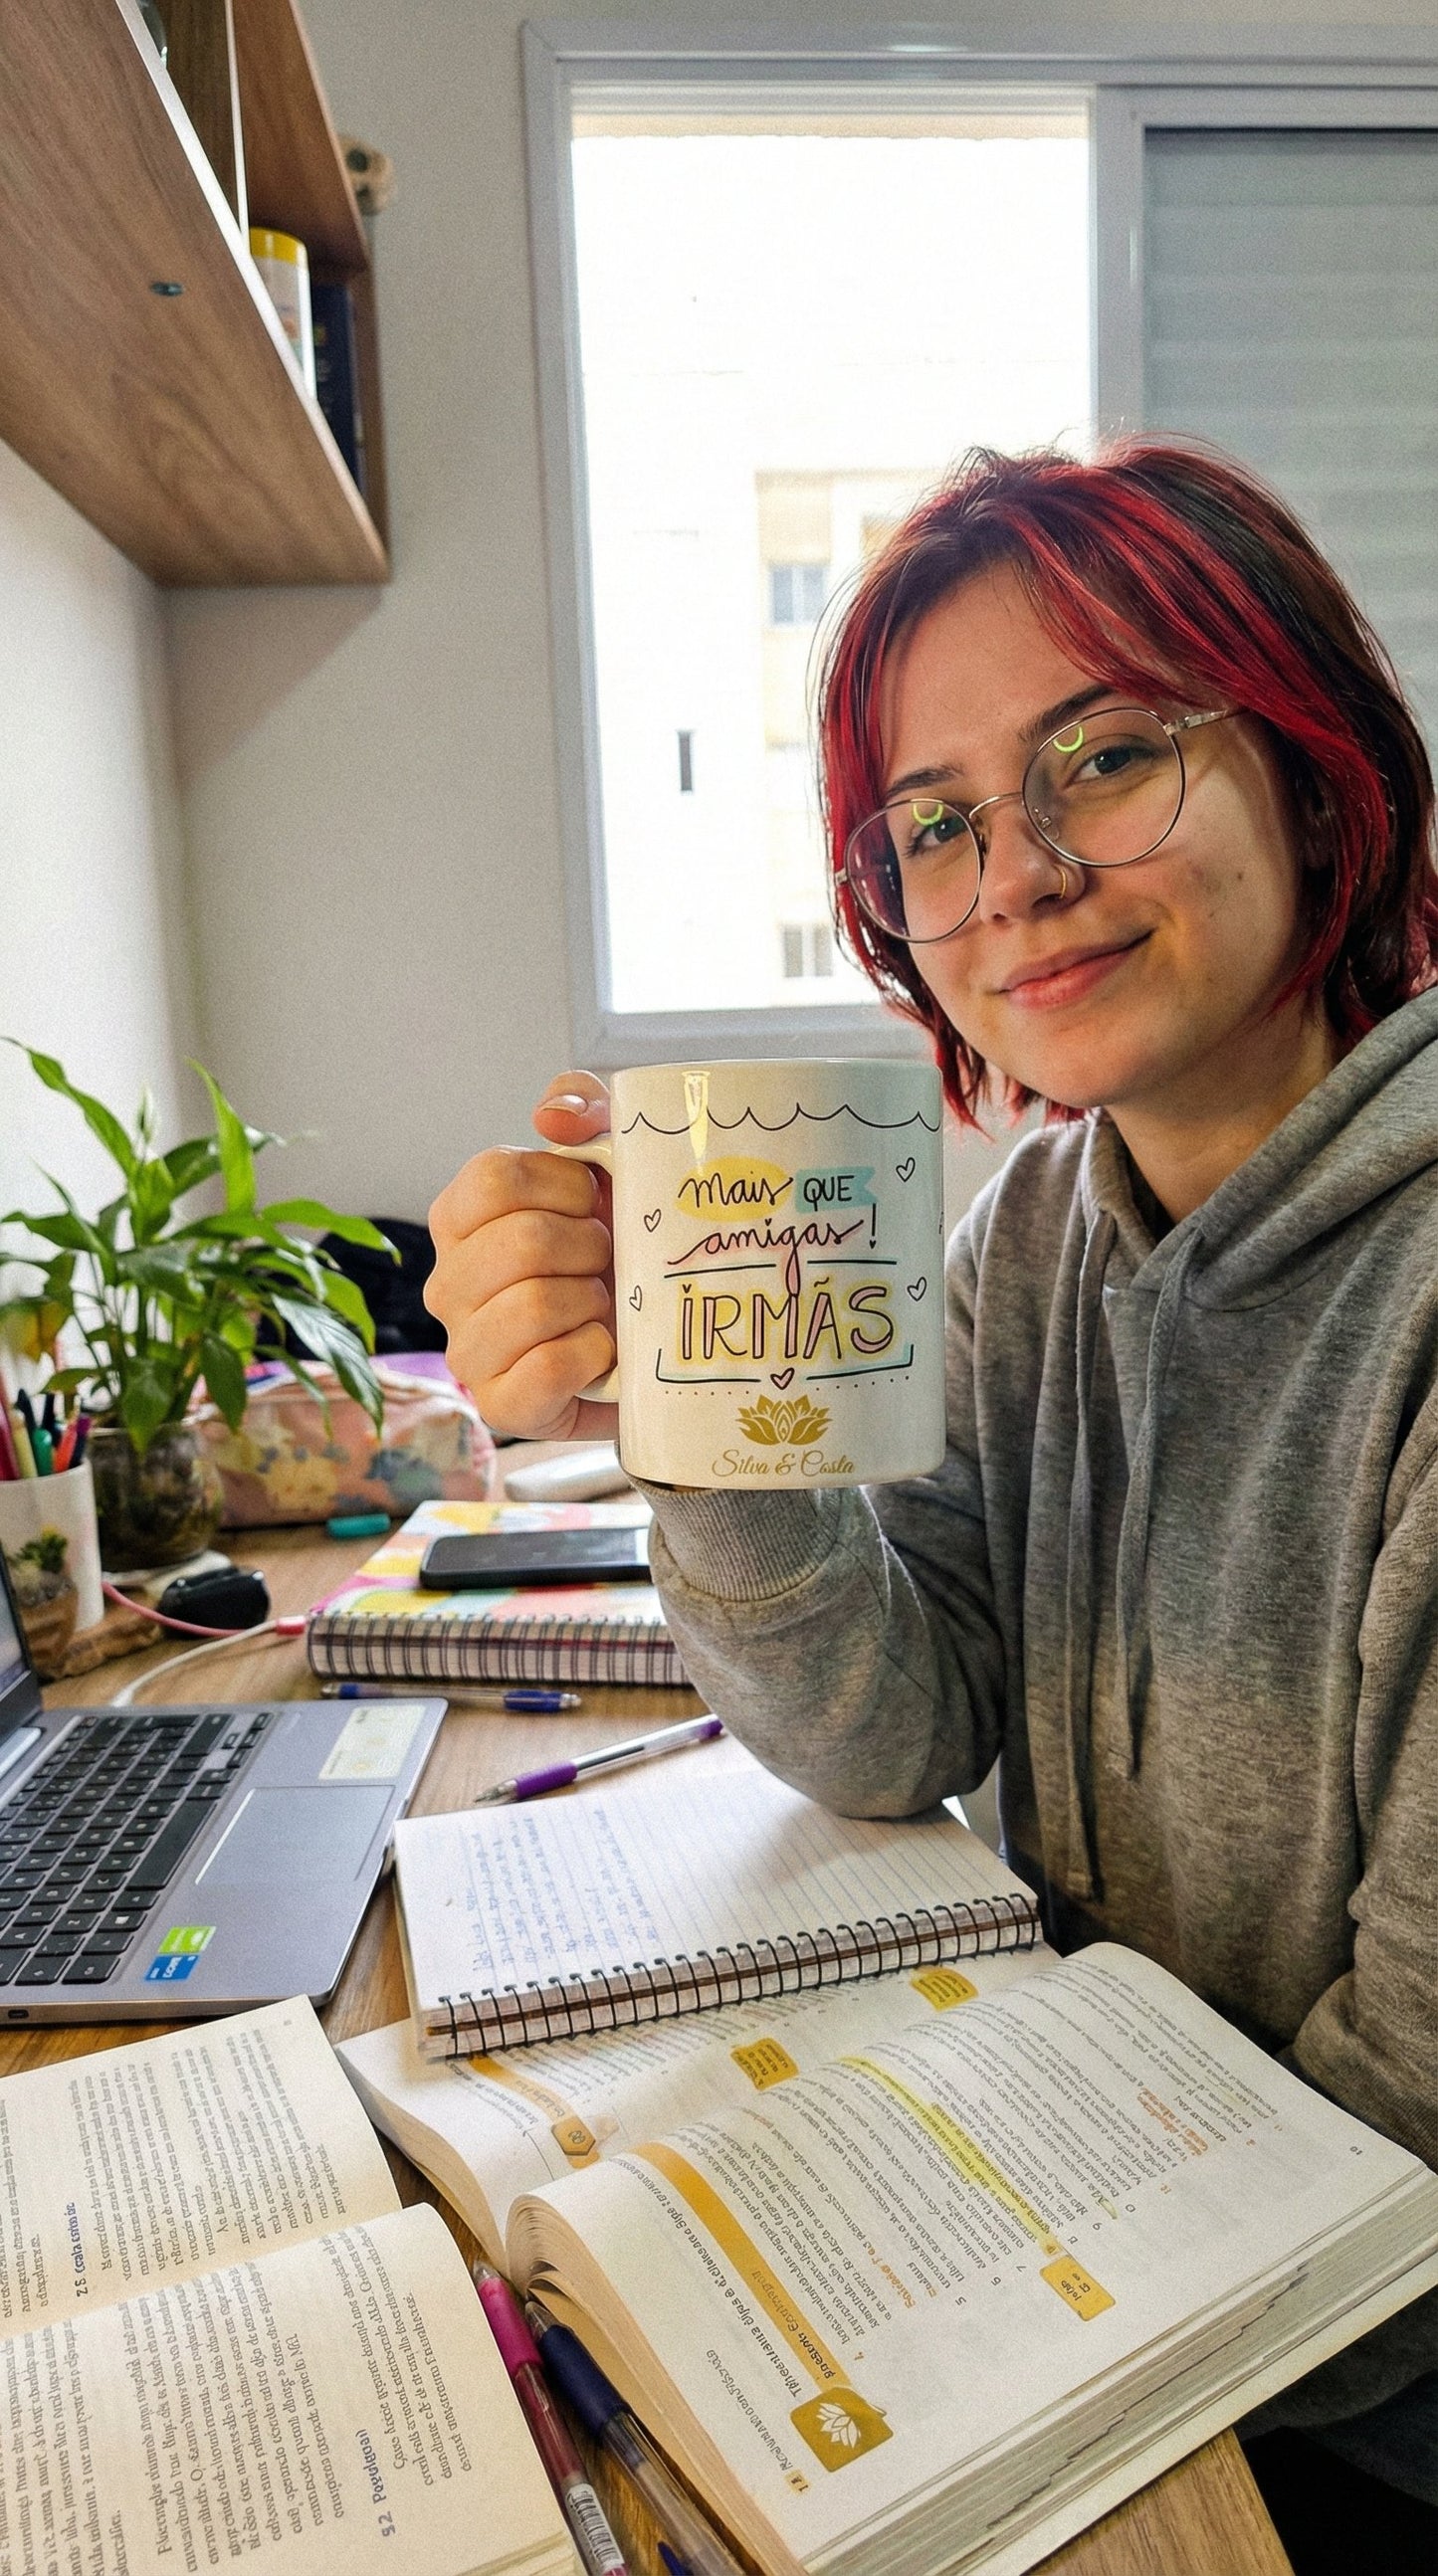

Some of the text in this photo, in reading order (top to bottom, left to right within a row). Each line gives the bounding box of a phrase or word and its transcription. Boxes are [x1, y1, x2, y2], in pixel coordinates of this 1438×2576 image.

[803, 1175, 855, 1212] QUE
[712, 1449, 854, 1478] Silva & Costa
